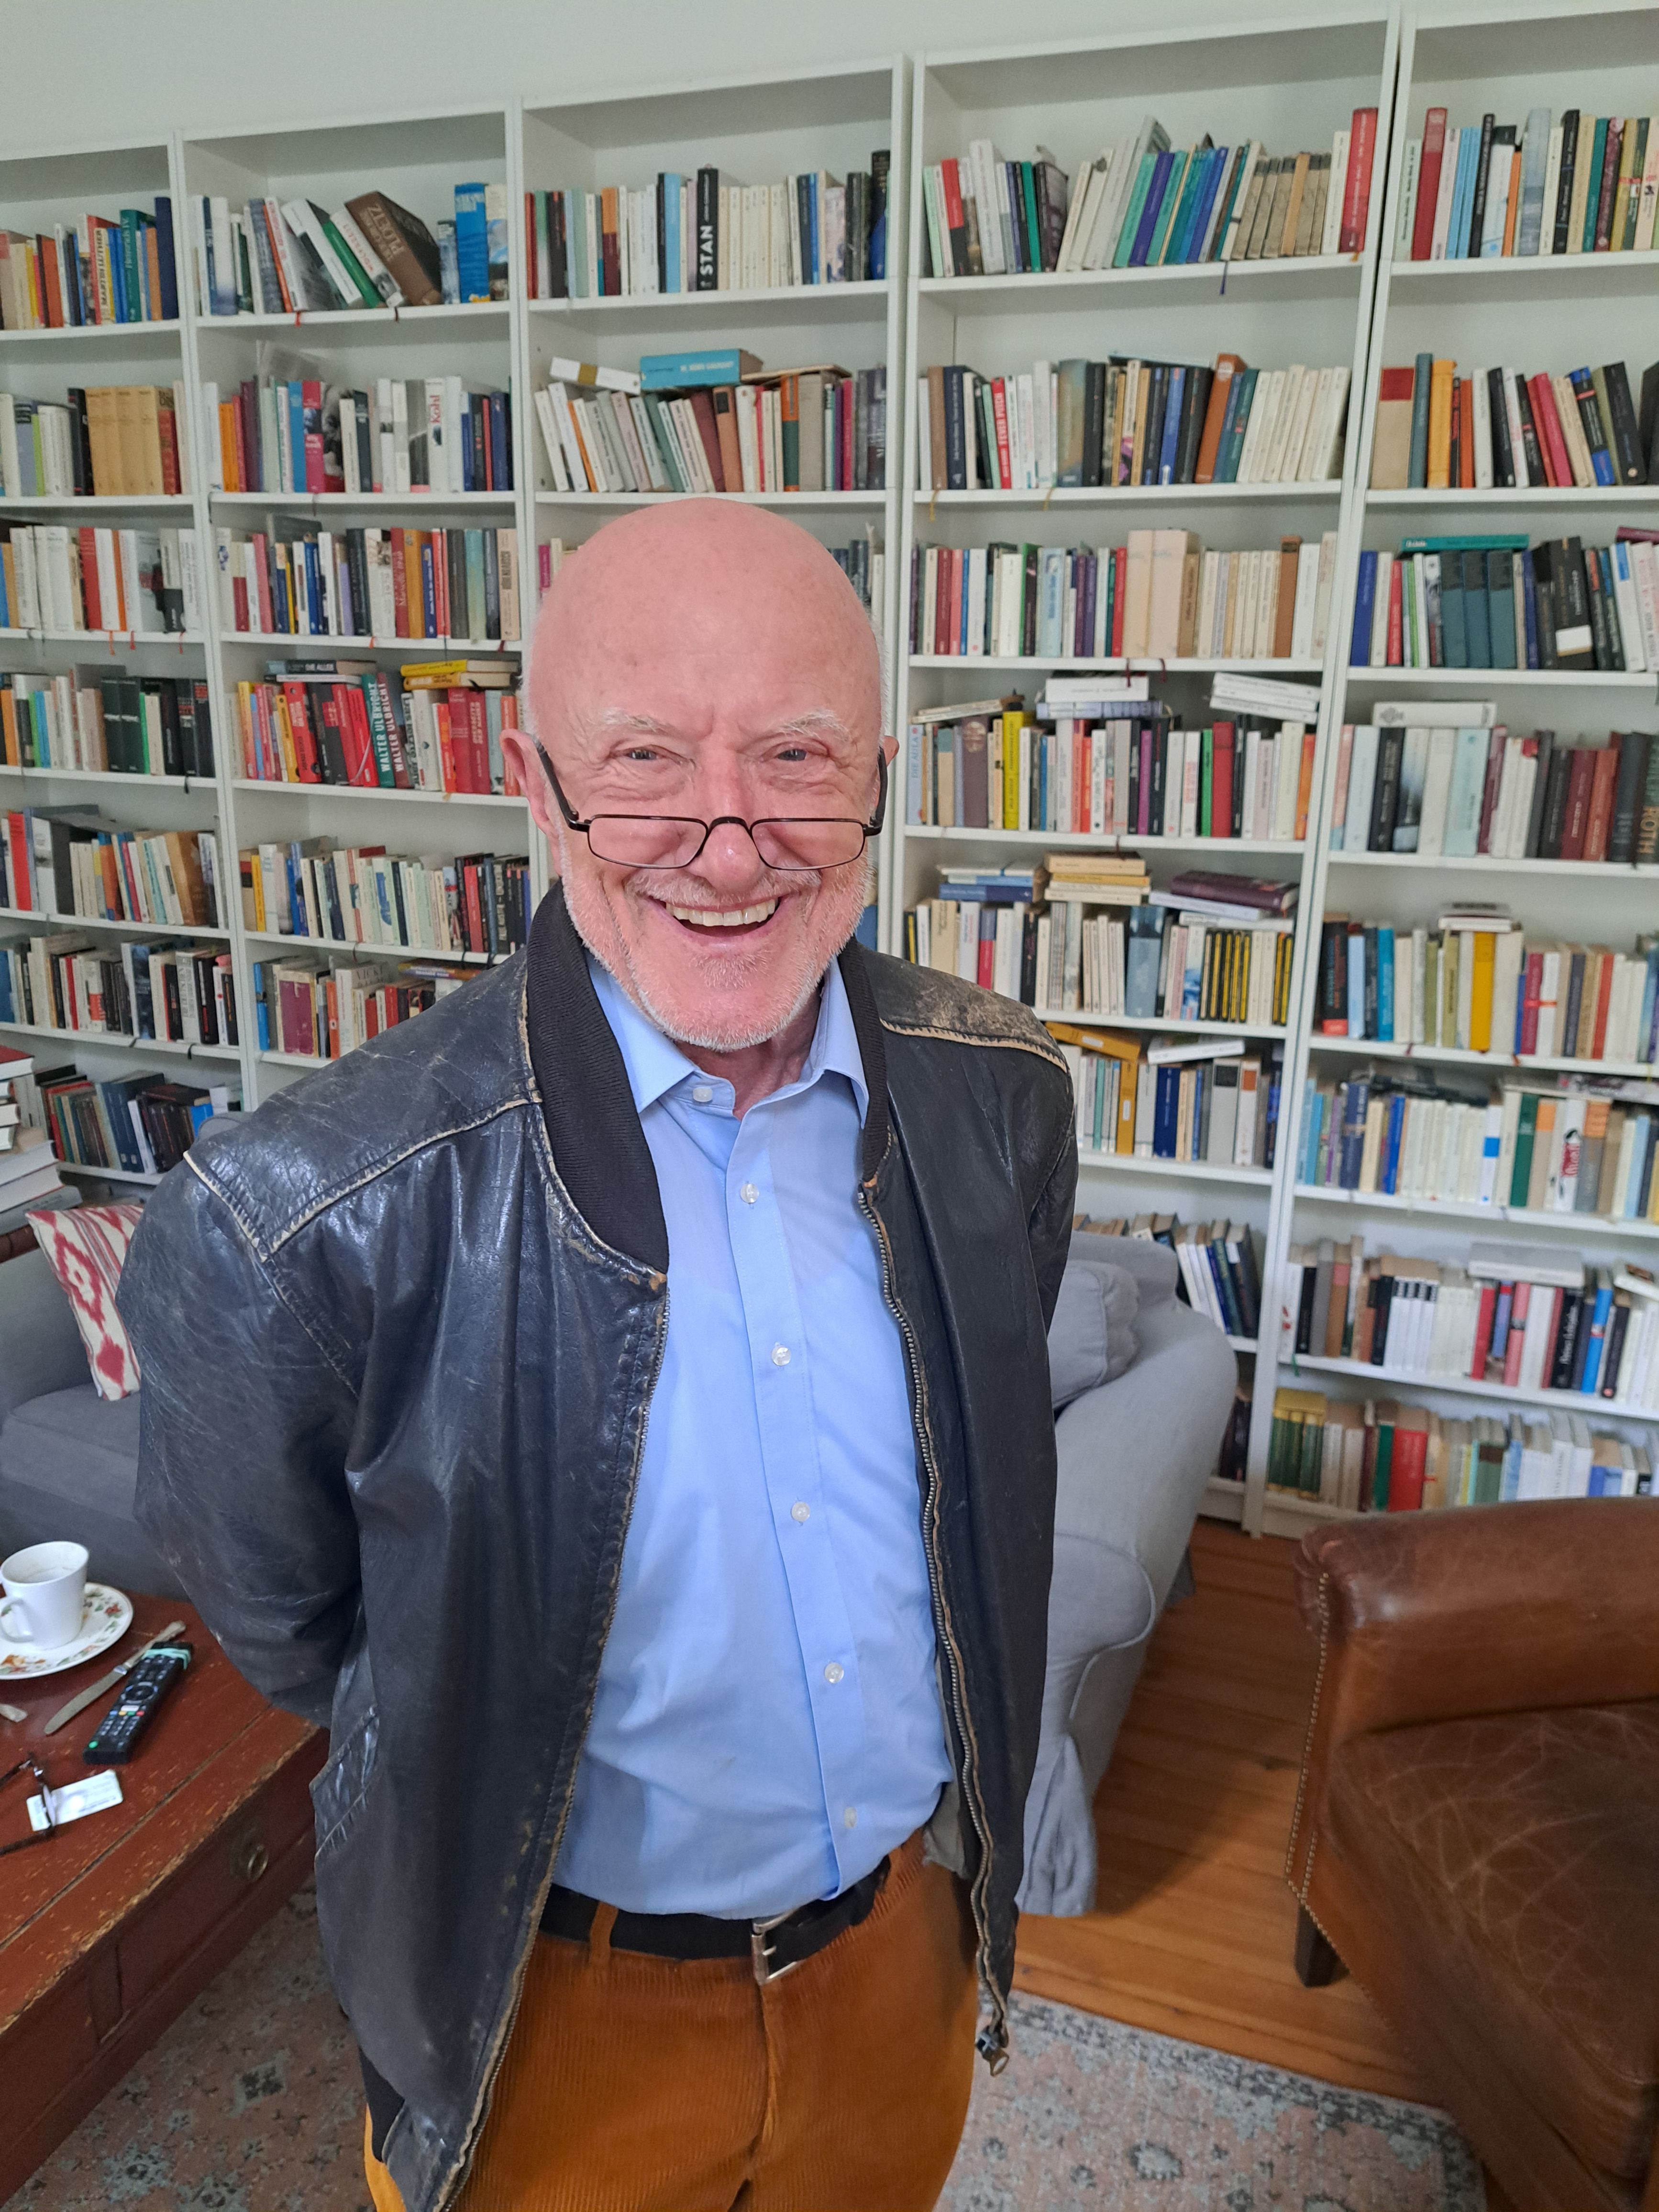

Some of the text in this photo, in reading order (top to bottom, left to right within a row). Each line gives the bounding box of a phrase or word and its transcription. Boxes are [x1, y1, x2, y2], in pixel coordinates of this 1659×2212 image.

[95, 229, 106, 266] LUTHER
[366, 205, 403, 254] PLOETZ
[700, 225, 713, 276] STAN
[429, 395, 441, 423] Kohl
[369, 683, 390, 772] WALTER ULBRICHT
[378, 683, 404, 772] WALTER ULBRICHT
[1638, 806, 1658, 855] ROTH
